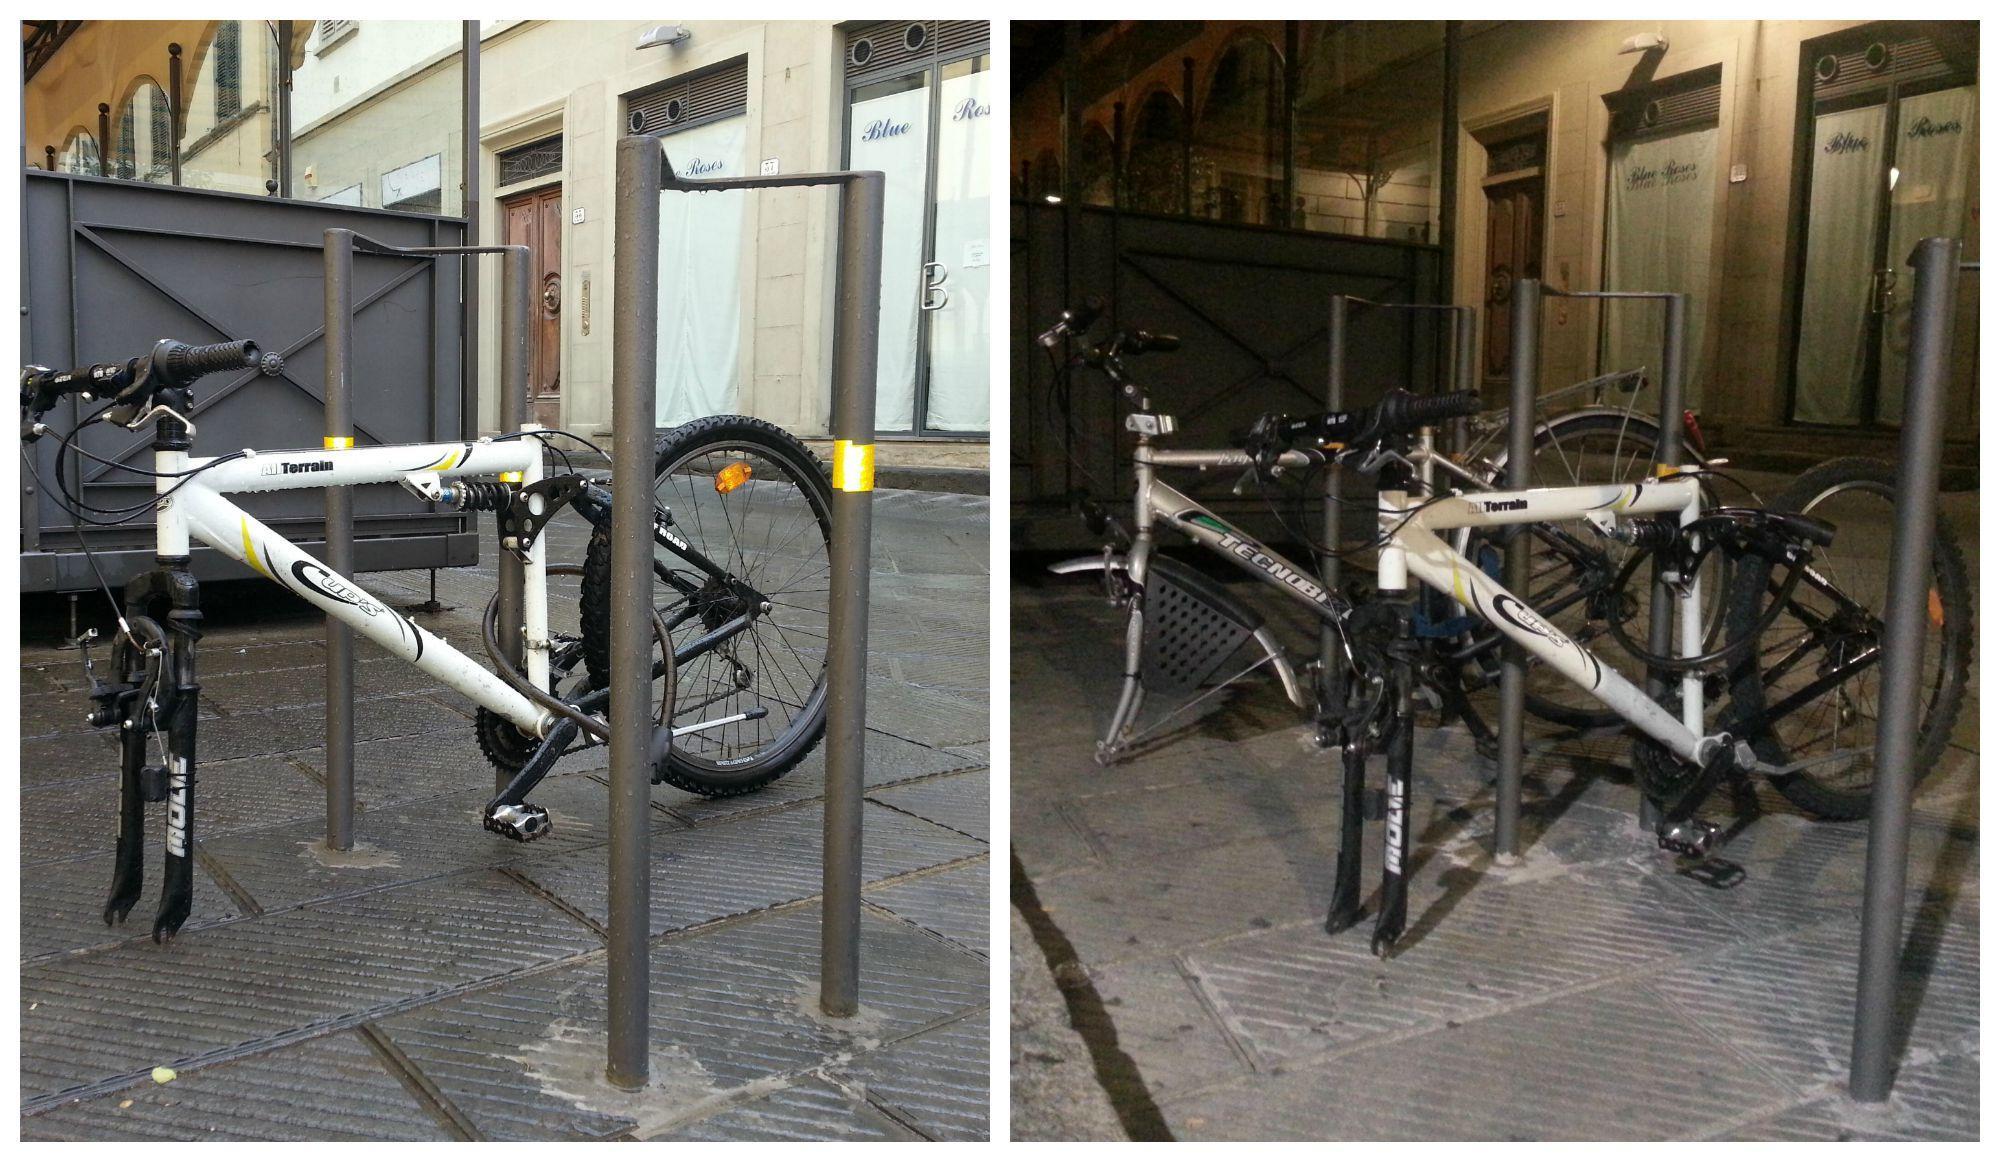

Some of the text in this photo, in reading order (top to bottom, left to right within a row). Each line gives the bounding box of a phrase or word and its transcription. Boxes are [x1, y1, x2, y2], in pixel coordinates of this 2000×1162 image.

[862, 118, 912, 142] Blue
[686, 158, 724, 177] Roses
[281, 460, 334, 474] Terrain
[1484, 499, 1528, 512] Terrain
[659, 527, 688, 551] ROAD
[1218, 532, 1353, 620] TECNOBI
